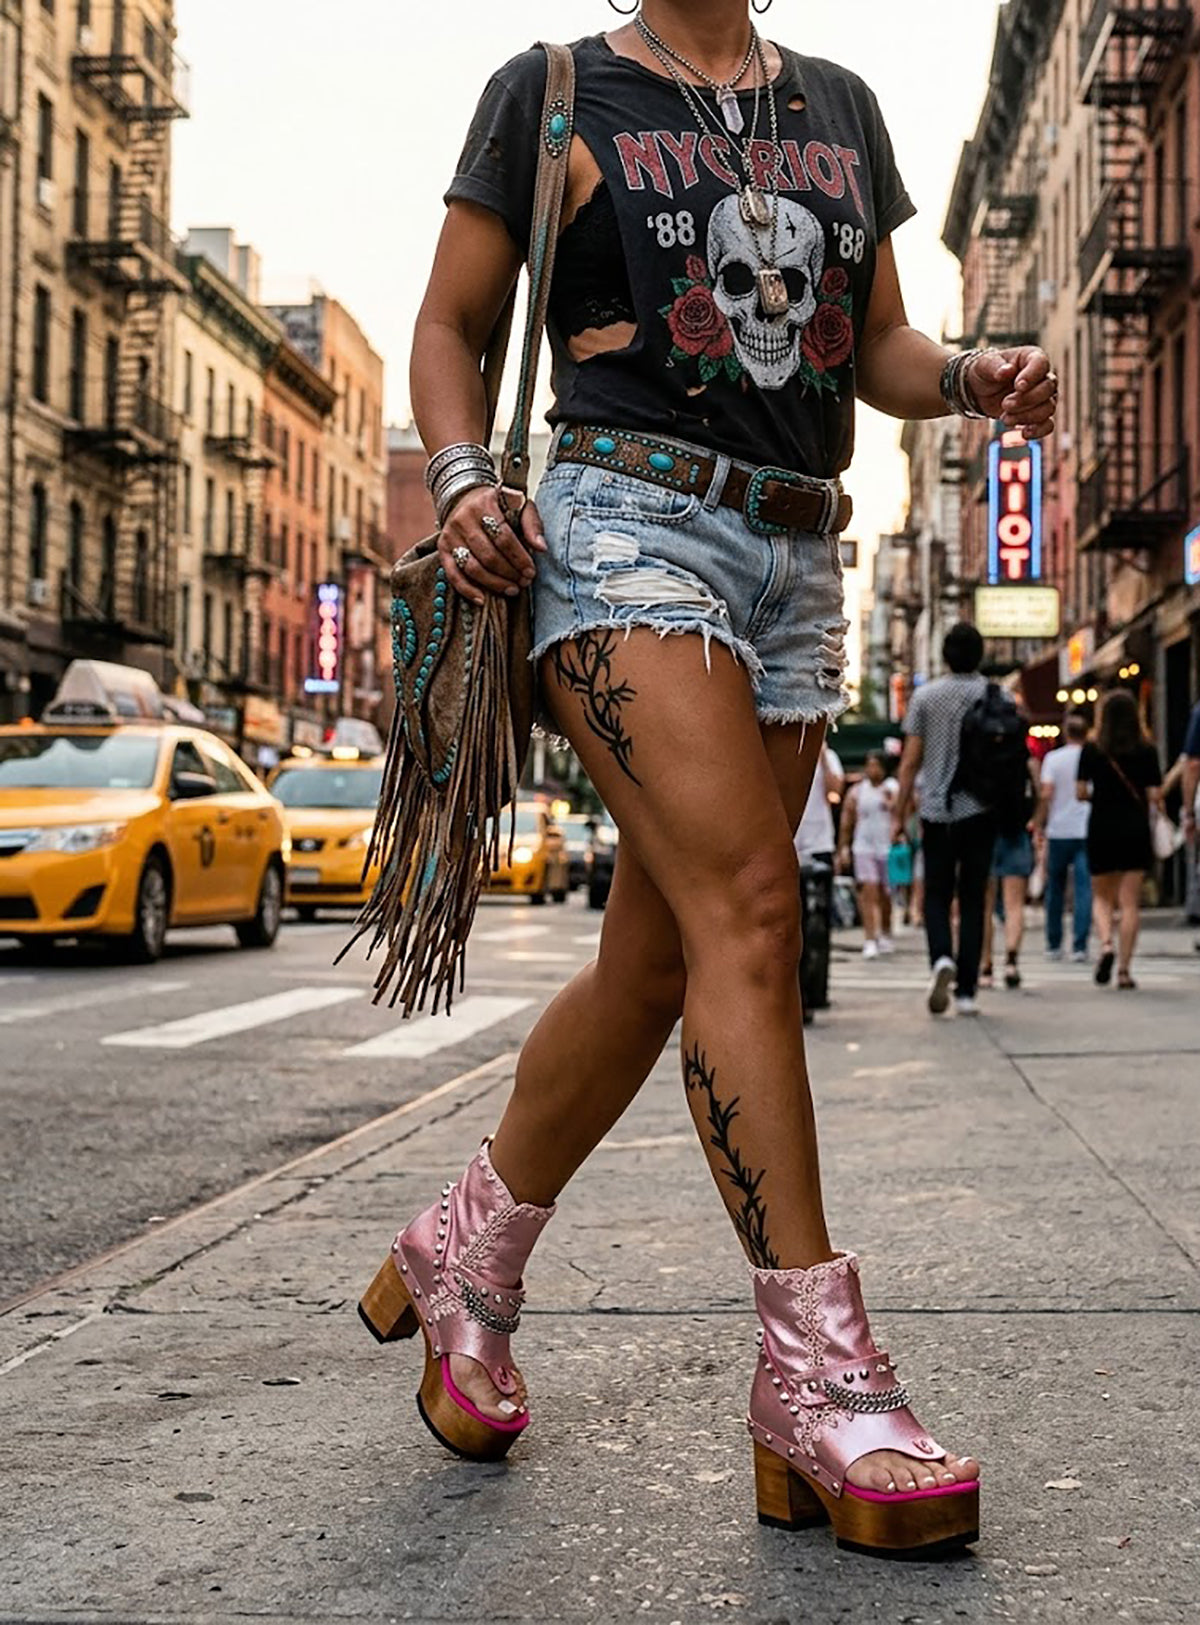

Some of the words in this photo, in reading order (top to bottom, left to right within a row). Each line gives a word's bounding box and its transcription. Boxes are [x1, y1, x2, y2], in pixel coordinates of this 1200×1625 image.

[612, 130, 739, 200] NYC
[747, 138, 868, 223] RIOT
[646, 209, 697, 249] '88
[831, 221, 866, 264] '88
